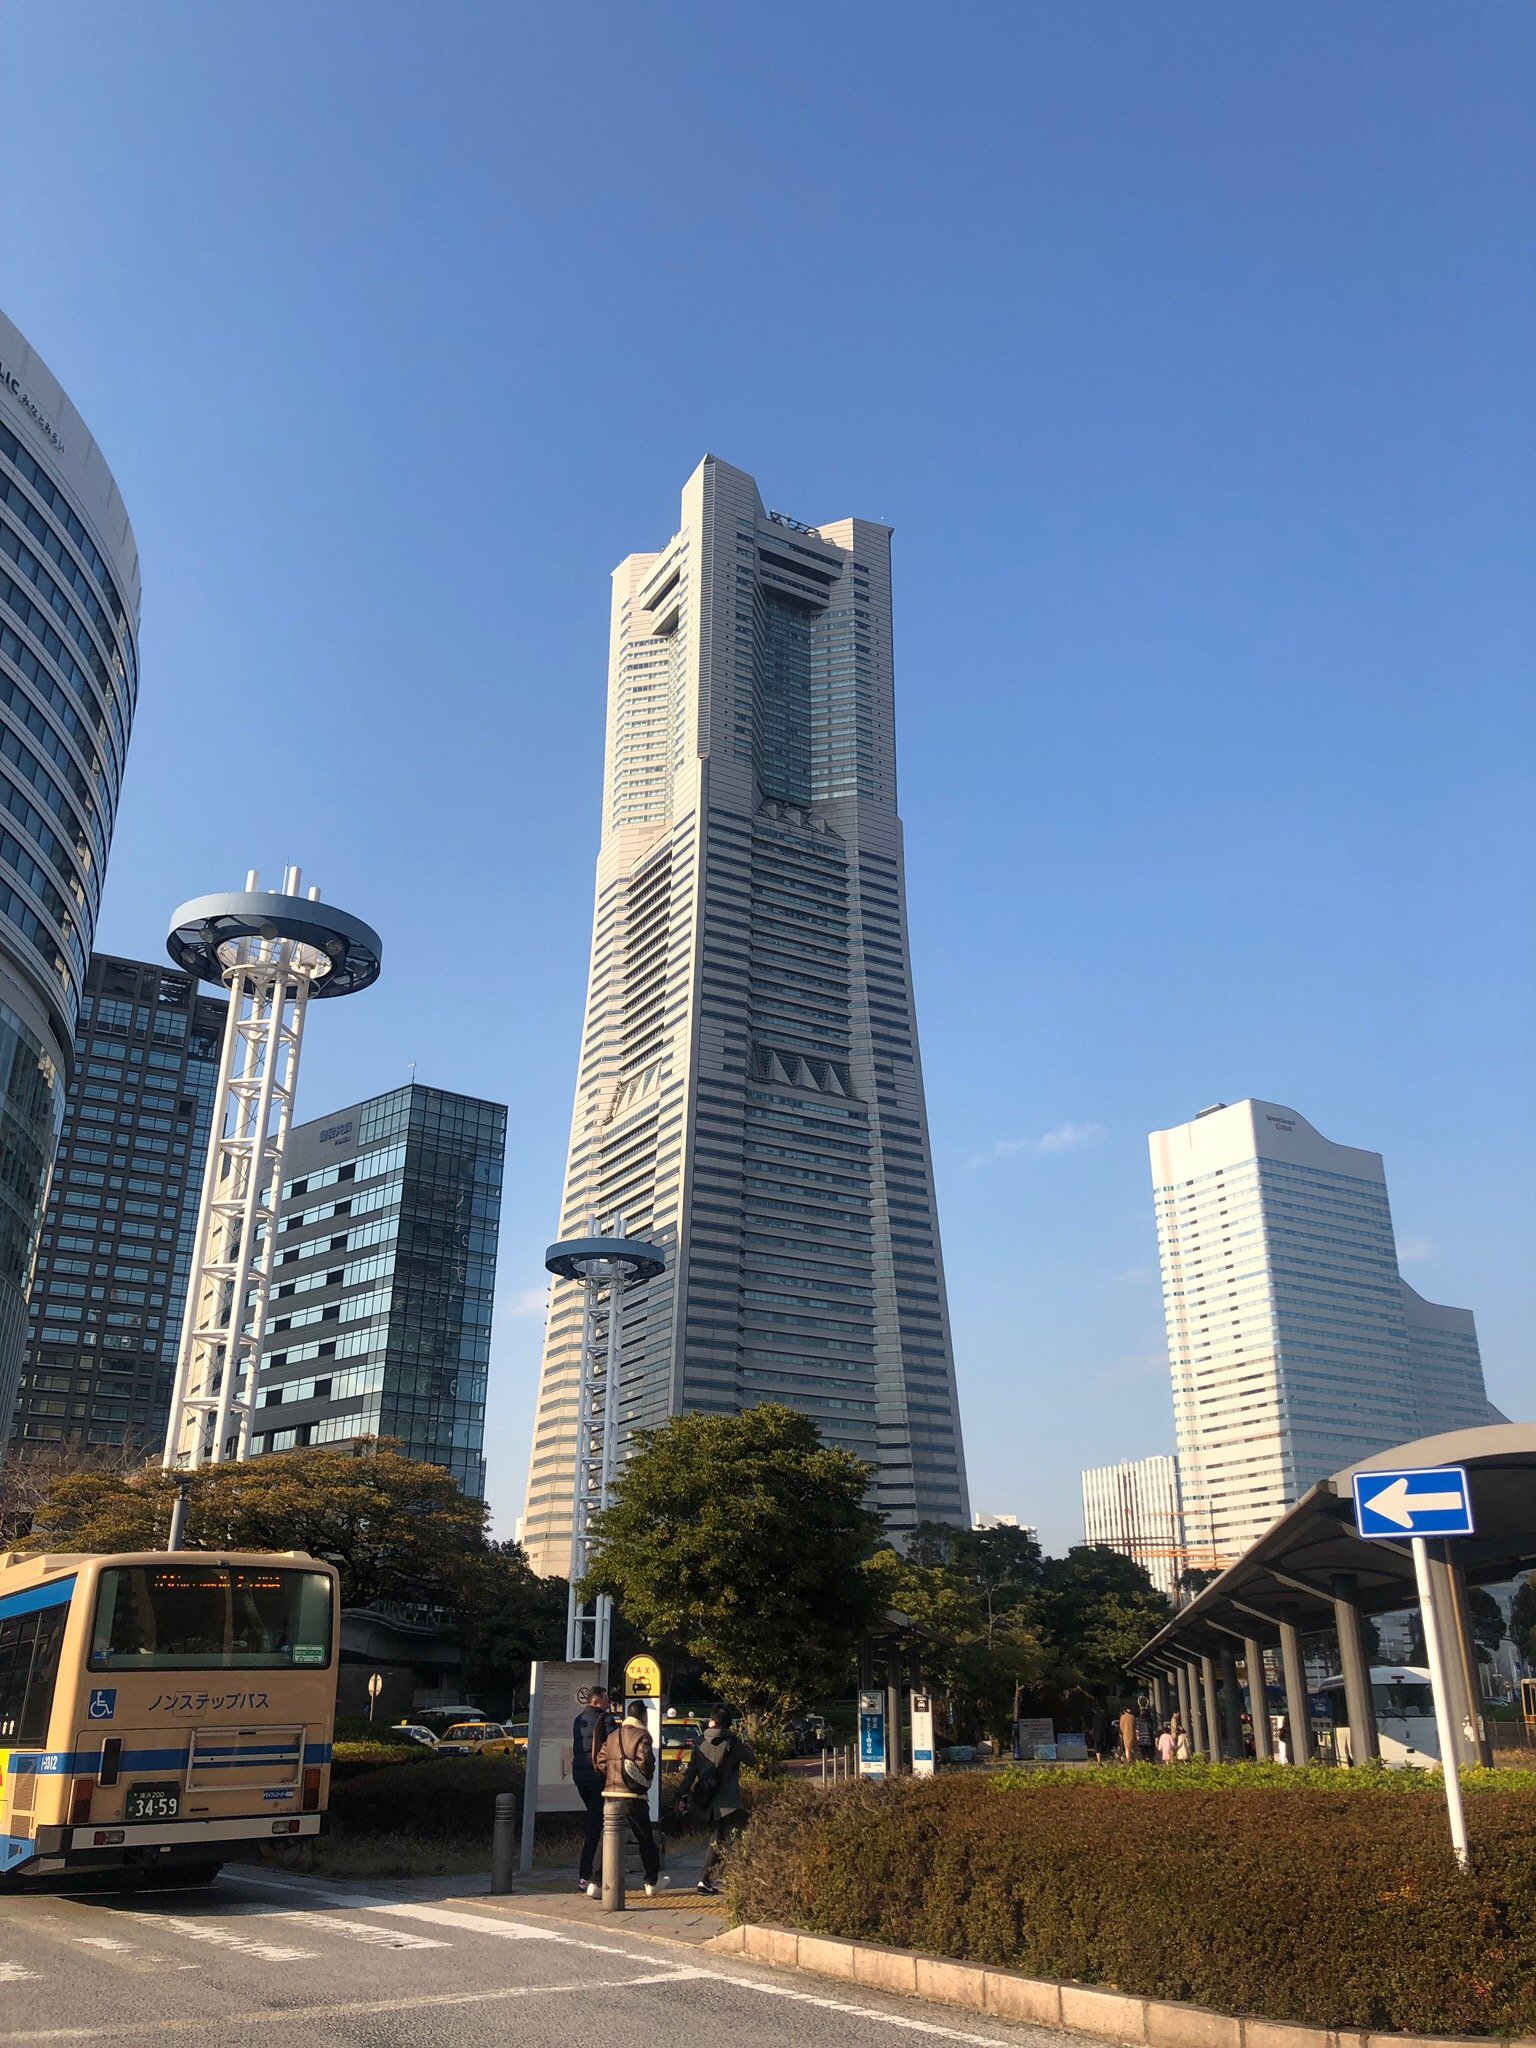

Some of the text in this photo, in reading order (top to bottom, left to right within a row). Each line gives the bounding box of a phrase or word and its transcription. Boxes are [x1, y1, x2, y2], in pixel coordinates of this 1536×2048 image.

[629, 1666, 656, 1674] TAXI
[148, 1692, 269, 1711] ノンステップバス
[135, 1798, 178, 1817] 34-59
